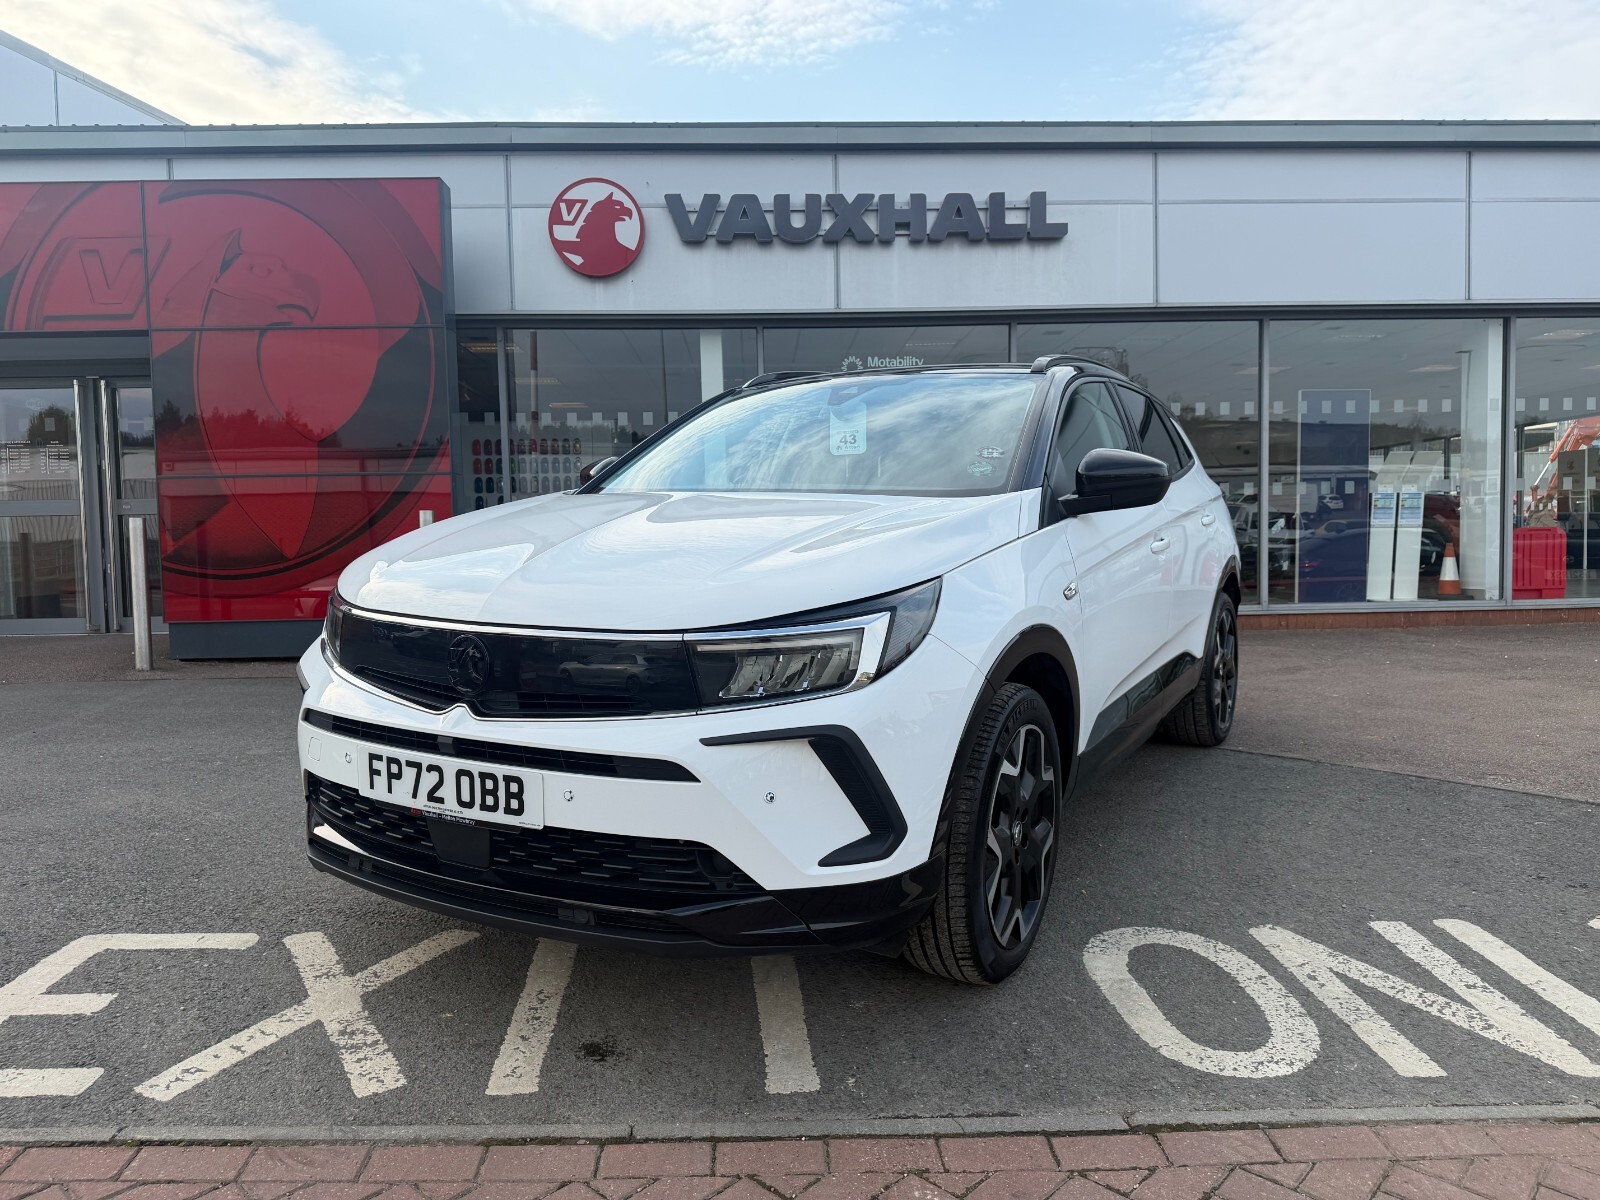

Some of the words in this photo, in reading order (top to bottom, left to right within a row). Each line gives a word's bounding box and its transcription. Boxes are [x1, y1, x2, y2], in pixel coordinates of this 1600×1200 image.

[664, 191, 1069, 243] VAUXHALL
[867, 356, 924, 368] Motability
[839, 434, 857, 445] 43
[368, 752, 445, 805] FP72
[455, 768, 525, 817] OBB
